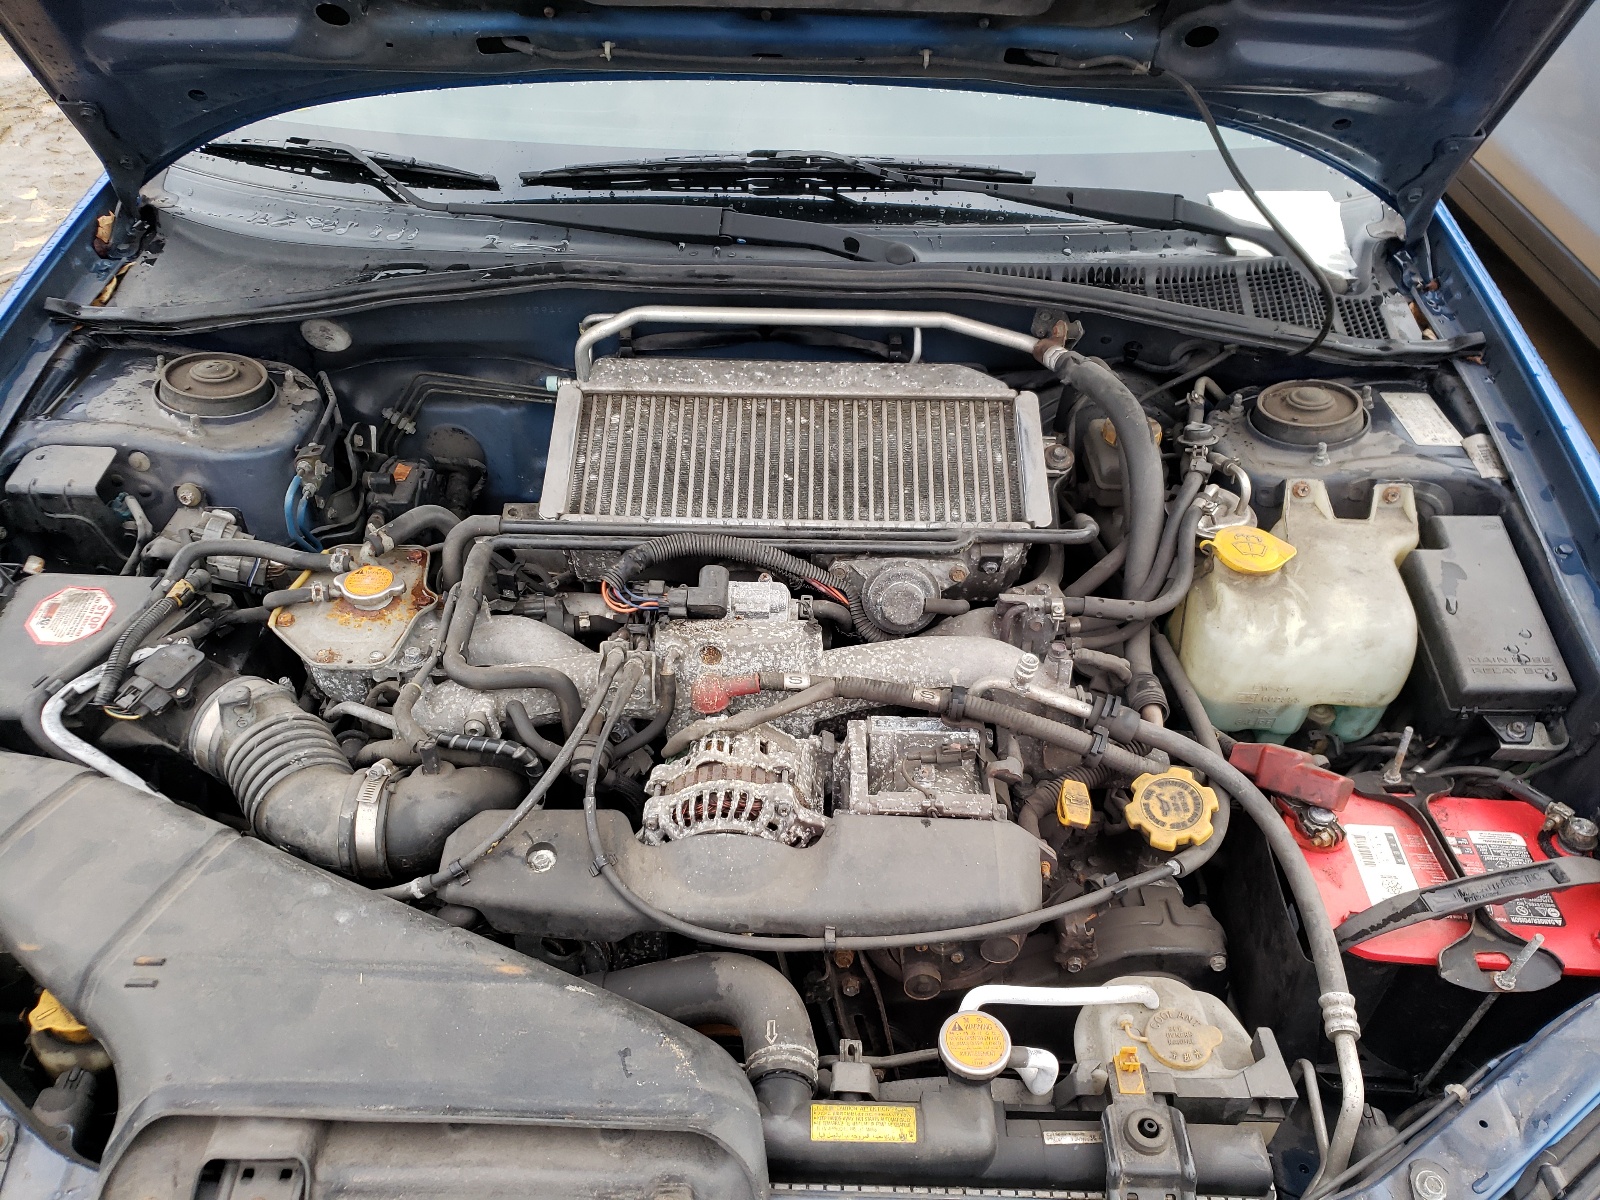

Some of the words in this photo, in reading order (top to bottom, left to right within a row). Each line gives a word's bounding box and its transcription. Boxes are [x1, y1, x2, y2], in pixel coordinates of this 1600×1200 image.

[88, 605, 108, 629] STOP
[1467, 656, 1508, 664] MAIN
[1511, 656, 1552, 665] FSE
[1472, 667, 1517, 675] RELAY
[788, 675, 803, 685] S
[919, 690, 936, 701] S
[1150, 1011, 1201, 1029] COOLANT
